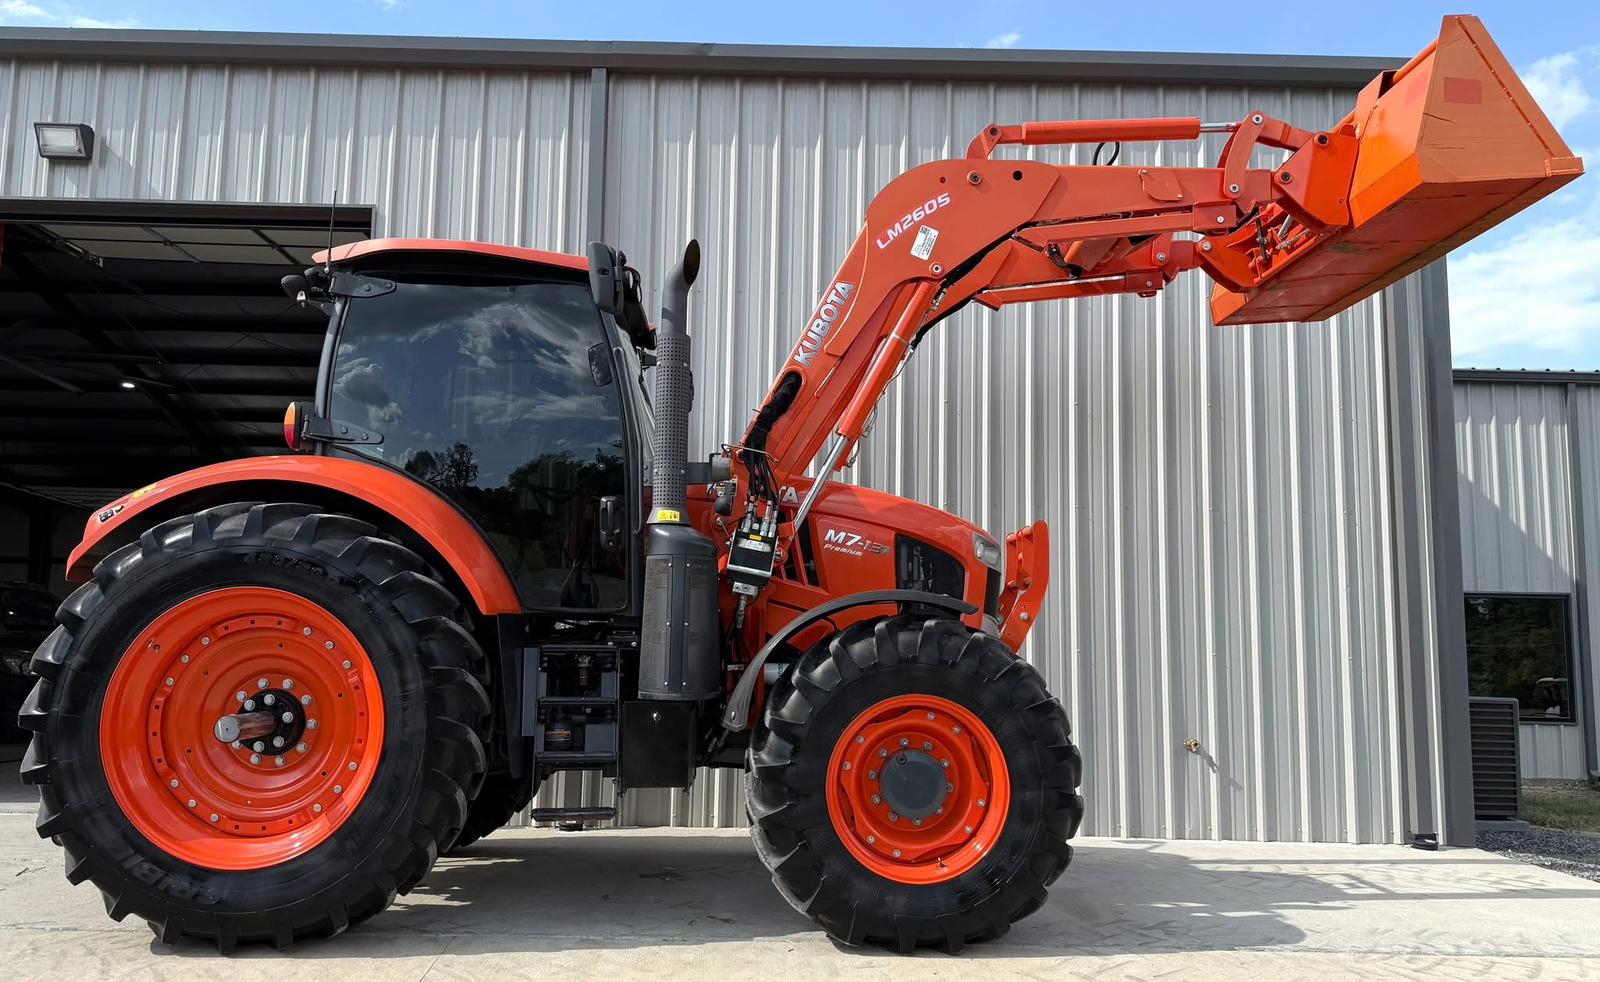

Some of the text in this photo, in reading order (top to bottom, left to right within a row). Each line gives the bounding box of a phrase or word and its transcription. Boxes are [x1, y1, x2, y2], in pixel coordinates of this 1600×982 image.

[876, 192, 950, 249] LM2605
[793, 281, 855, 367] KUBOTA
[823, 543, 863, 557] Premium
